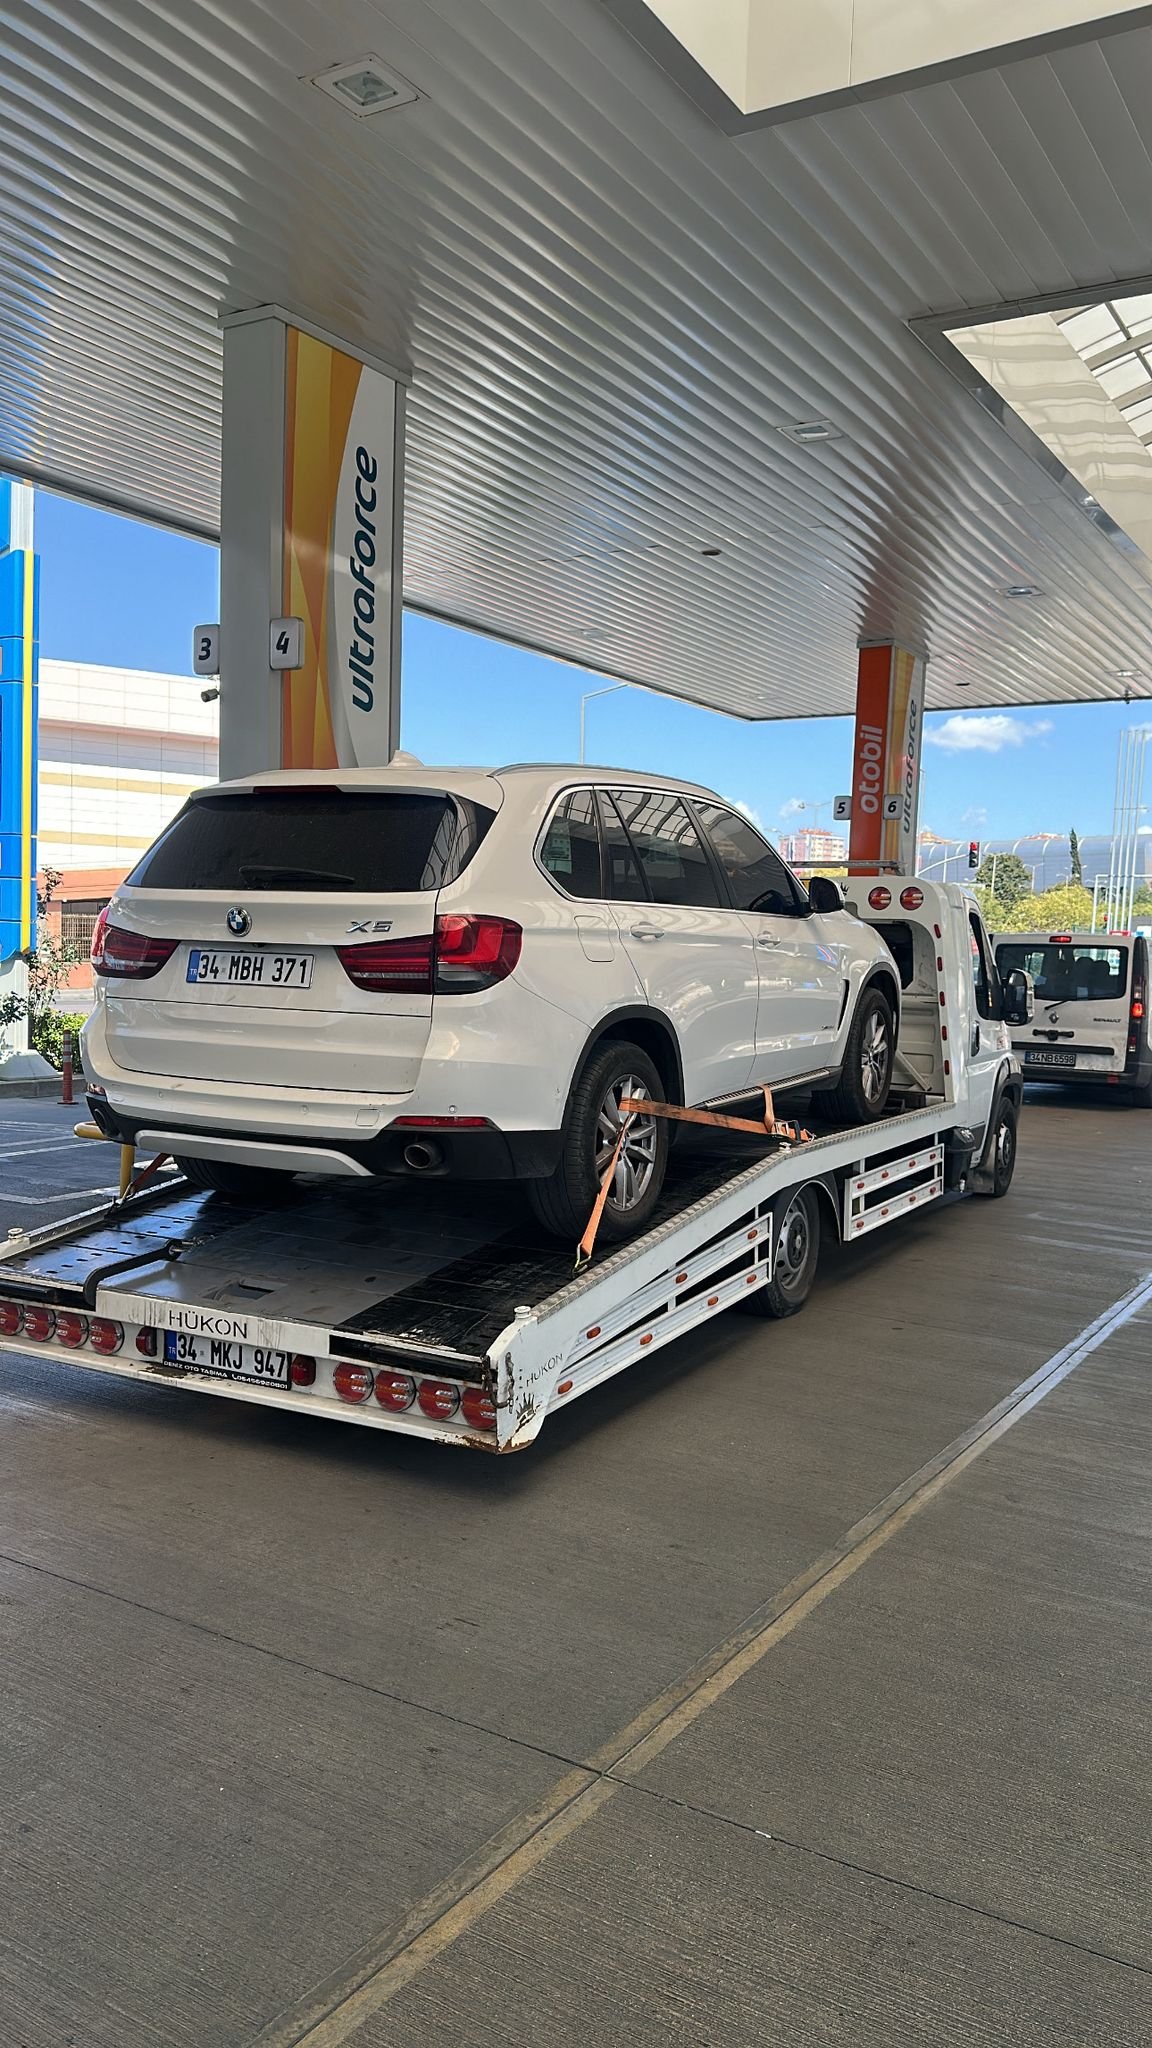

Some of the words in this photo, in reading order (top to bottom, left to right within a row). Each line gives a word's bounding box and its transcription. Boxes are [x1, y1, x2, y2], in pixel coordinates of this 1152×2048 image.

[349, 446, 378, 713] ultraforce
[198, 637, 212, 661] 3
[276, 631, 290, 655] 4
[859, 724, 883, 814] otobil
[904, 699, 918, 834] ultraforce
[836, 802, 846, 814] 5
[887, 801, 897, 813] 6
[346, 920, 393, 933] X5
[190, 968, 198, 976] TR
[198, 955, 219, 979] 34
[228, 955, 264, 981] MBH
[271, 958, 307, 983] 371
[169, 1310, 247, 1339] HÜKON
[178, 1334, 197, 1361] 34
[210, 1340, 243, 1370] MKJ
[254, 1349, 286, 1378] 947
[184, 1365, 200, 1373] OTO
